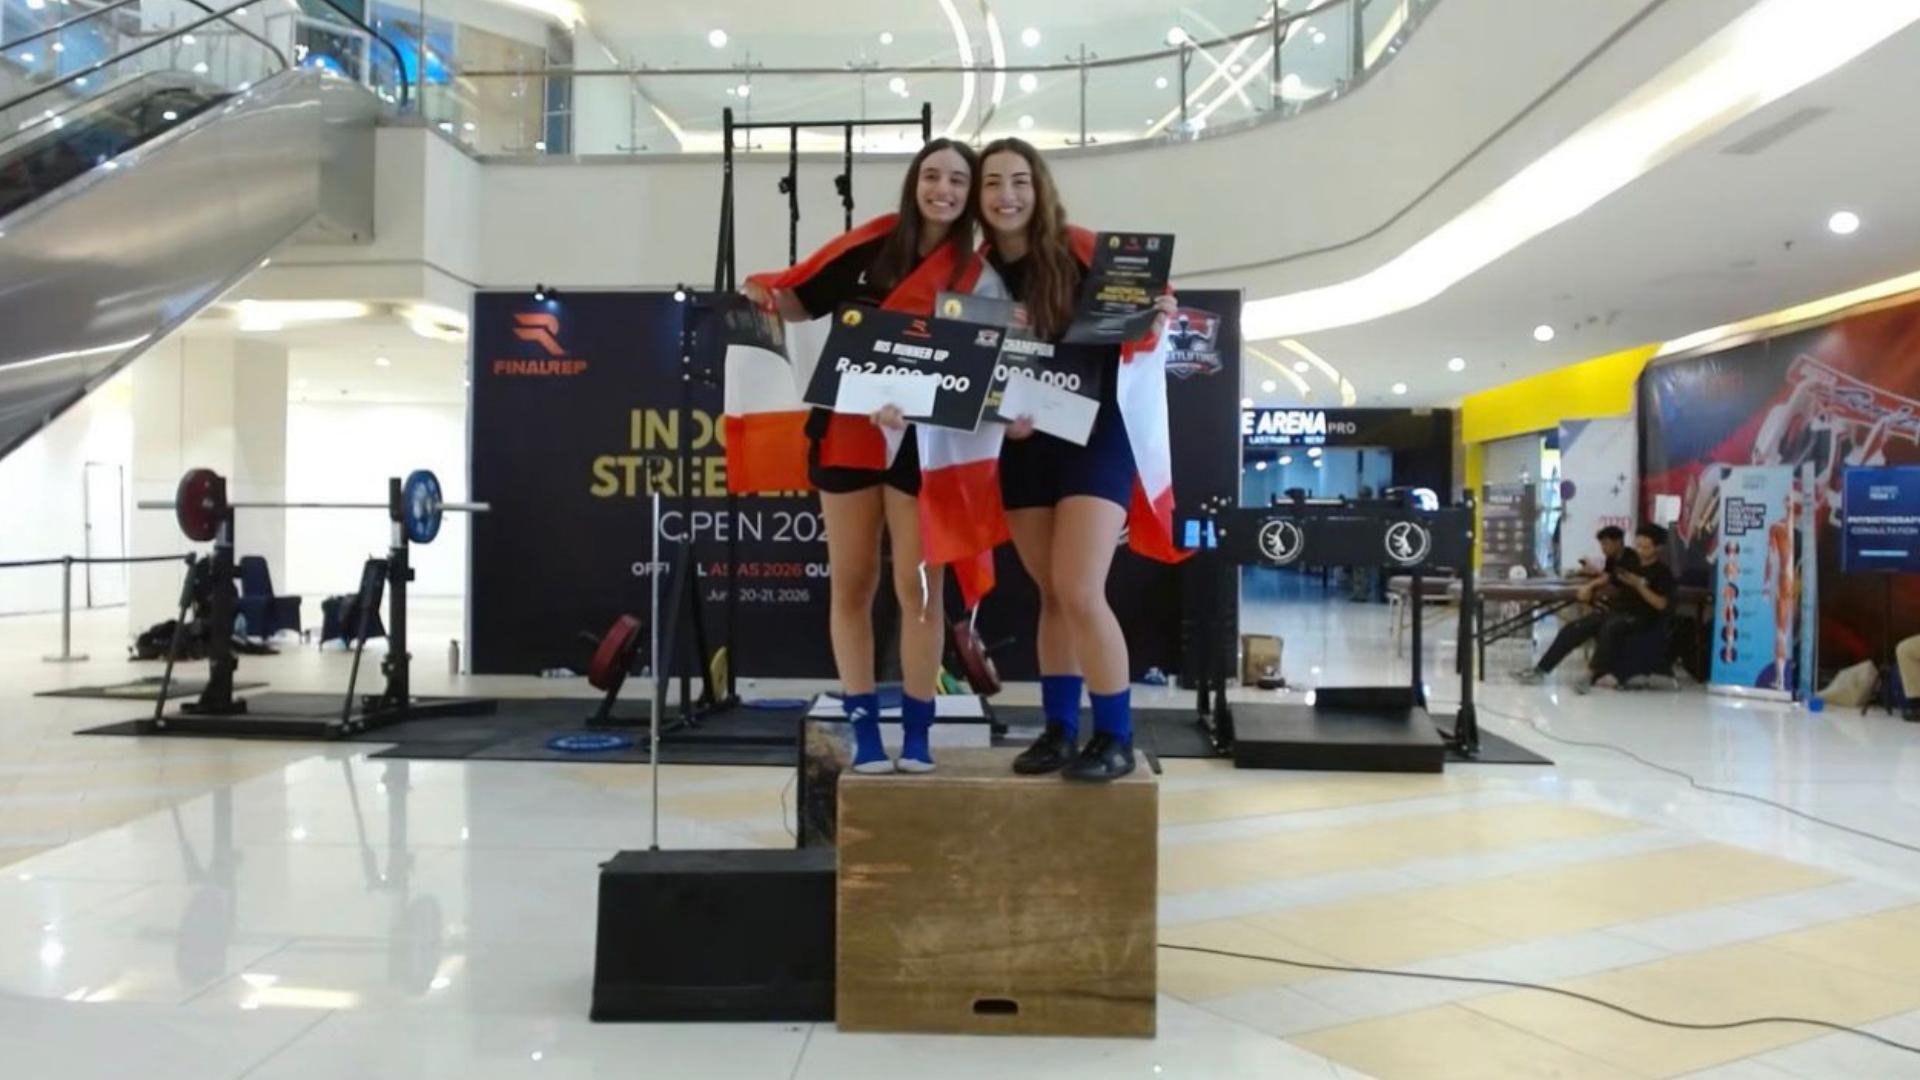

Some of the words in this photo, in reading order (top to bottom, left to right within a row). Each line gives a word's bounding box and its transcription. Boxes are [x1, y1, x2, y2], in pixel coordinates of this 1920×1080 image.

[891, 343, 934, 360] RUNNER
[933, 349, 950, 362] UP
[494, 360, 587, 375] FINALREP
[1242, 411, 1256, 434] E
[1257, 410, 1326, 435] ARENA
[1328, 421, 1356, 434] PRO
[773, 511, 829, 542] 202
[1851, 526, 1919, 535] CONSULTATION
[762, 562, 804, 577] 2026
[805, 562, 831, 577] QU
[778, 588, 810, 602] 2026
